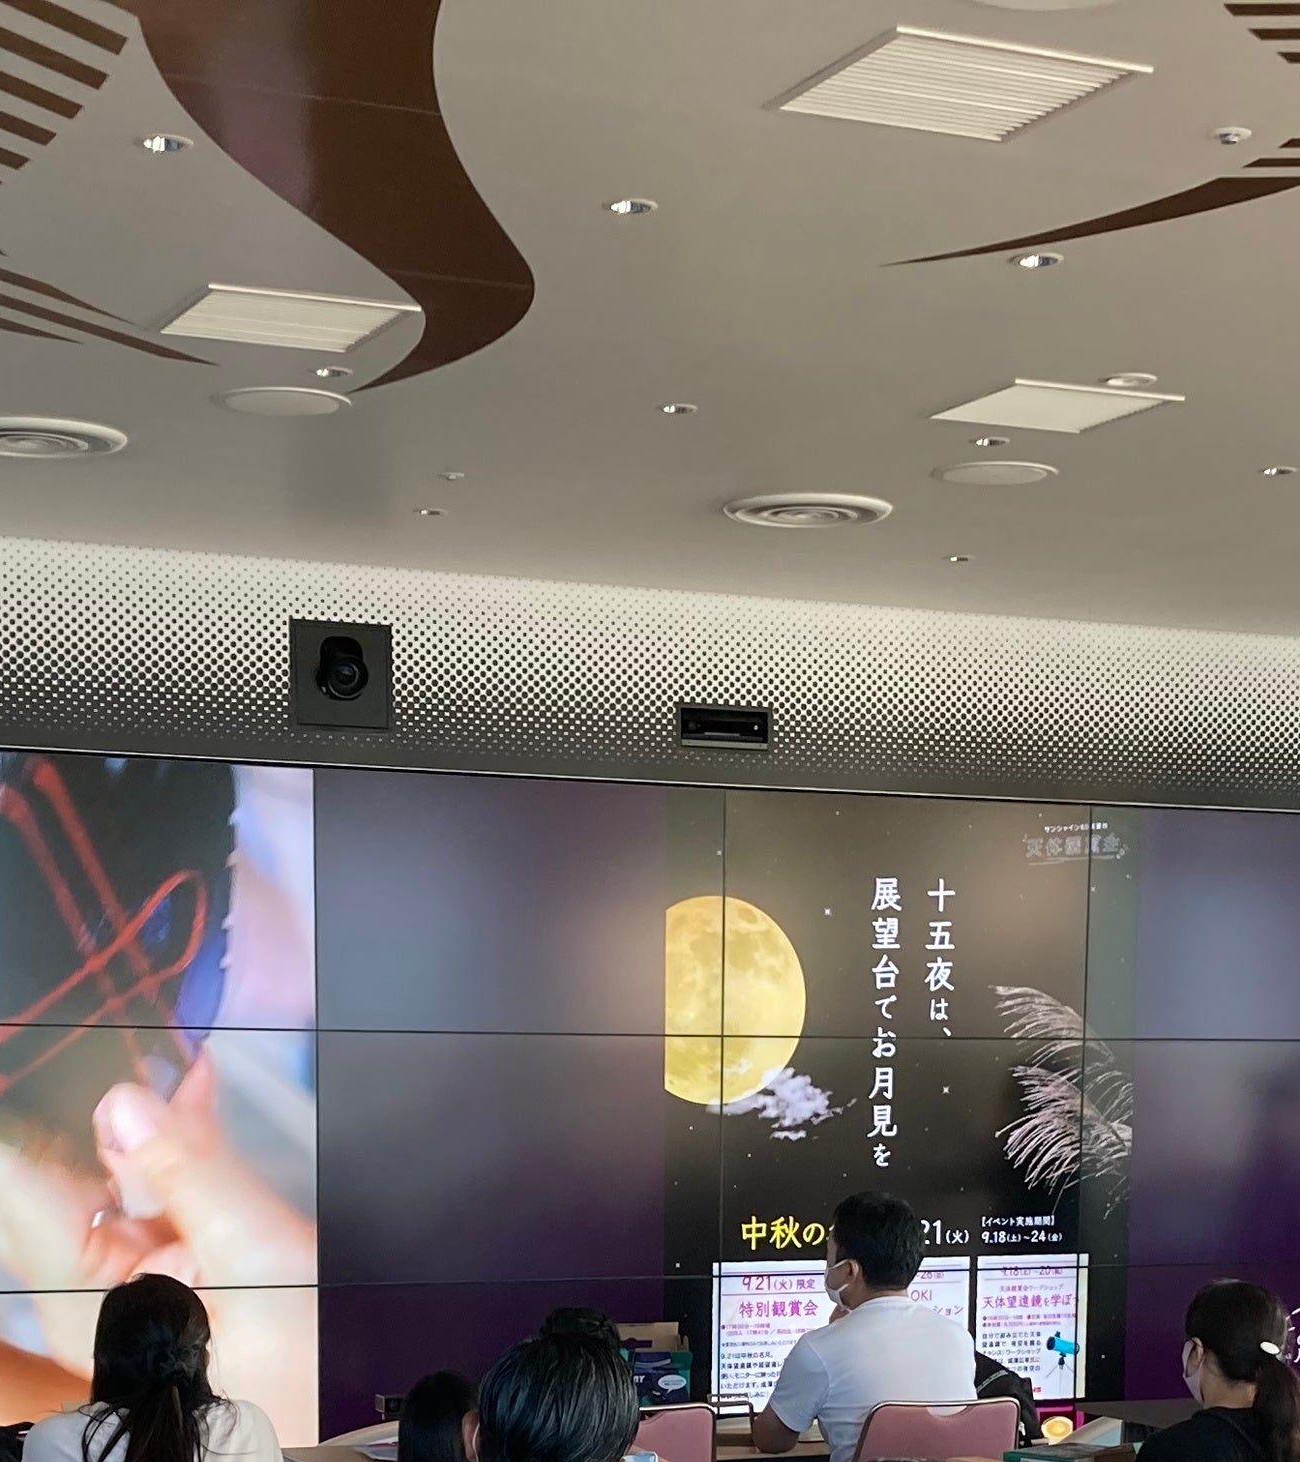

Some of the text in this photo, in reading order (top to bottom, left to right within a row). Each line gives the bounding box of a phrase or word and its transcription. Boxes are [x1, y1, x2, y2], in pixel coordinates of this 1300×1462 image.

[924, 878, 956, 1037] 十五夜は、
[741, 1215, 835, 1250] 中秋の
[738, 1298, 819, 1319] 特別観賞会
